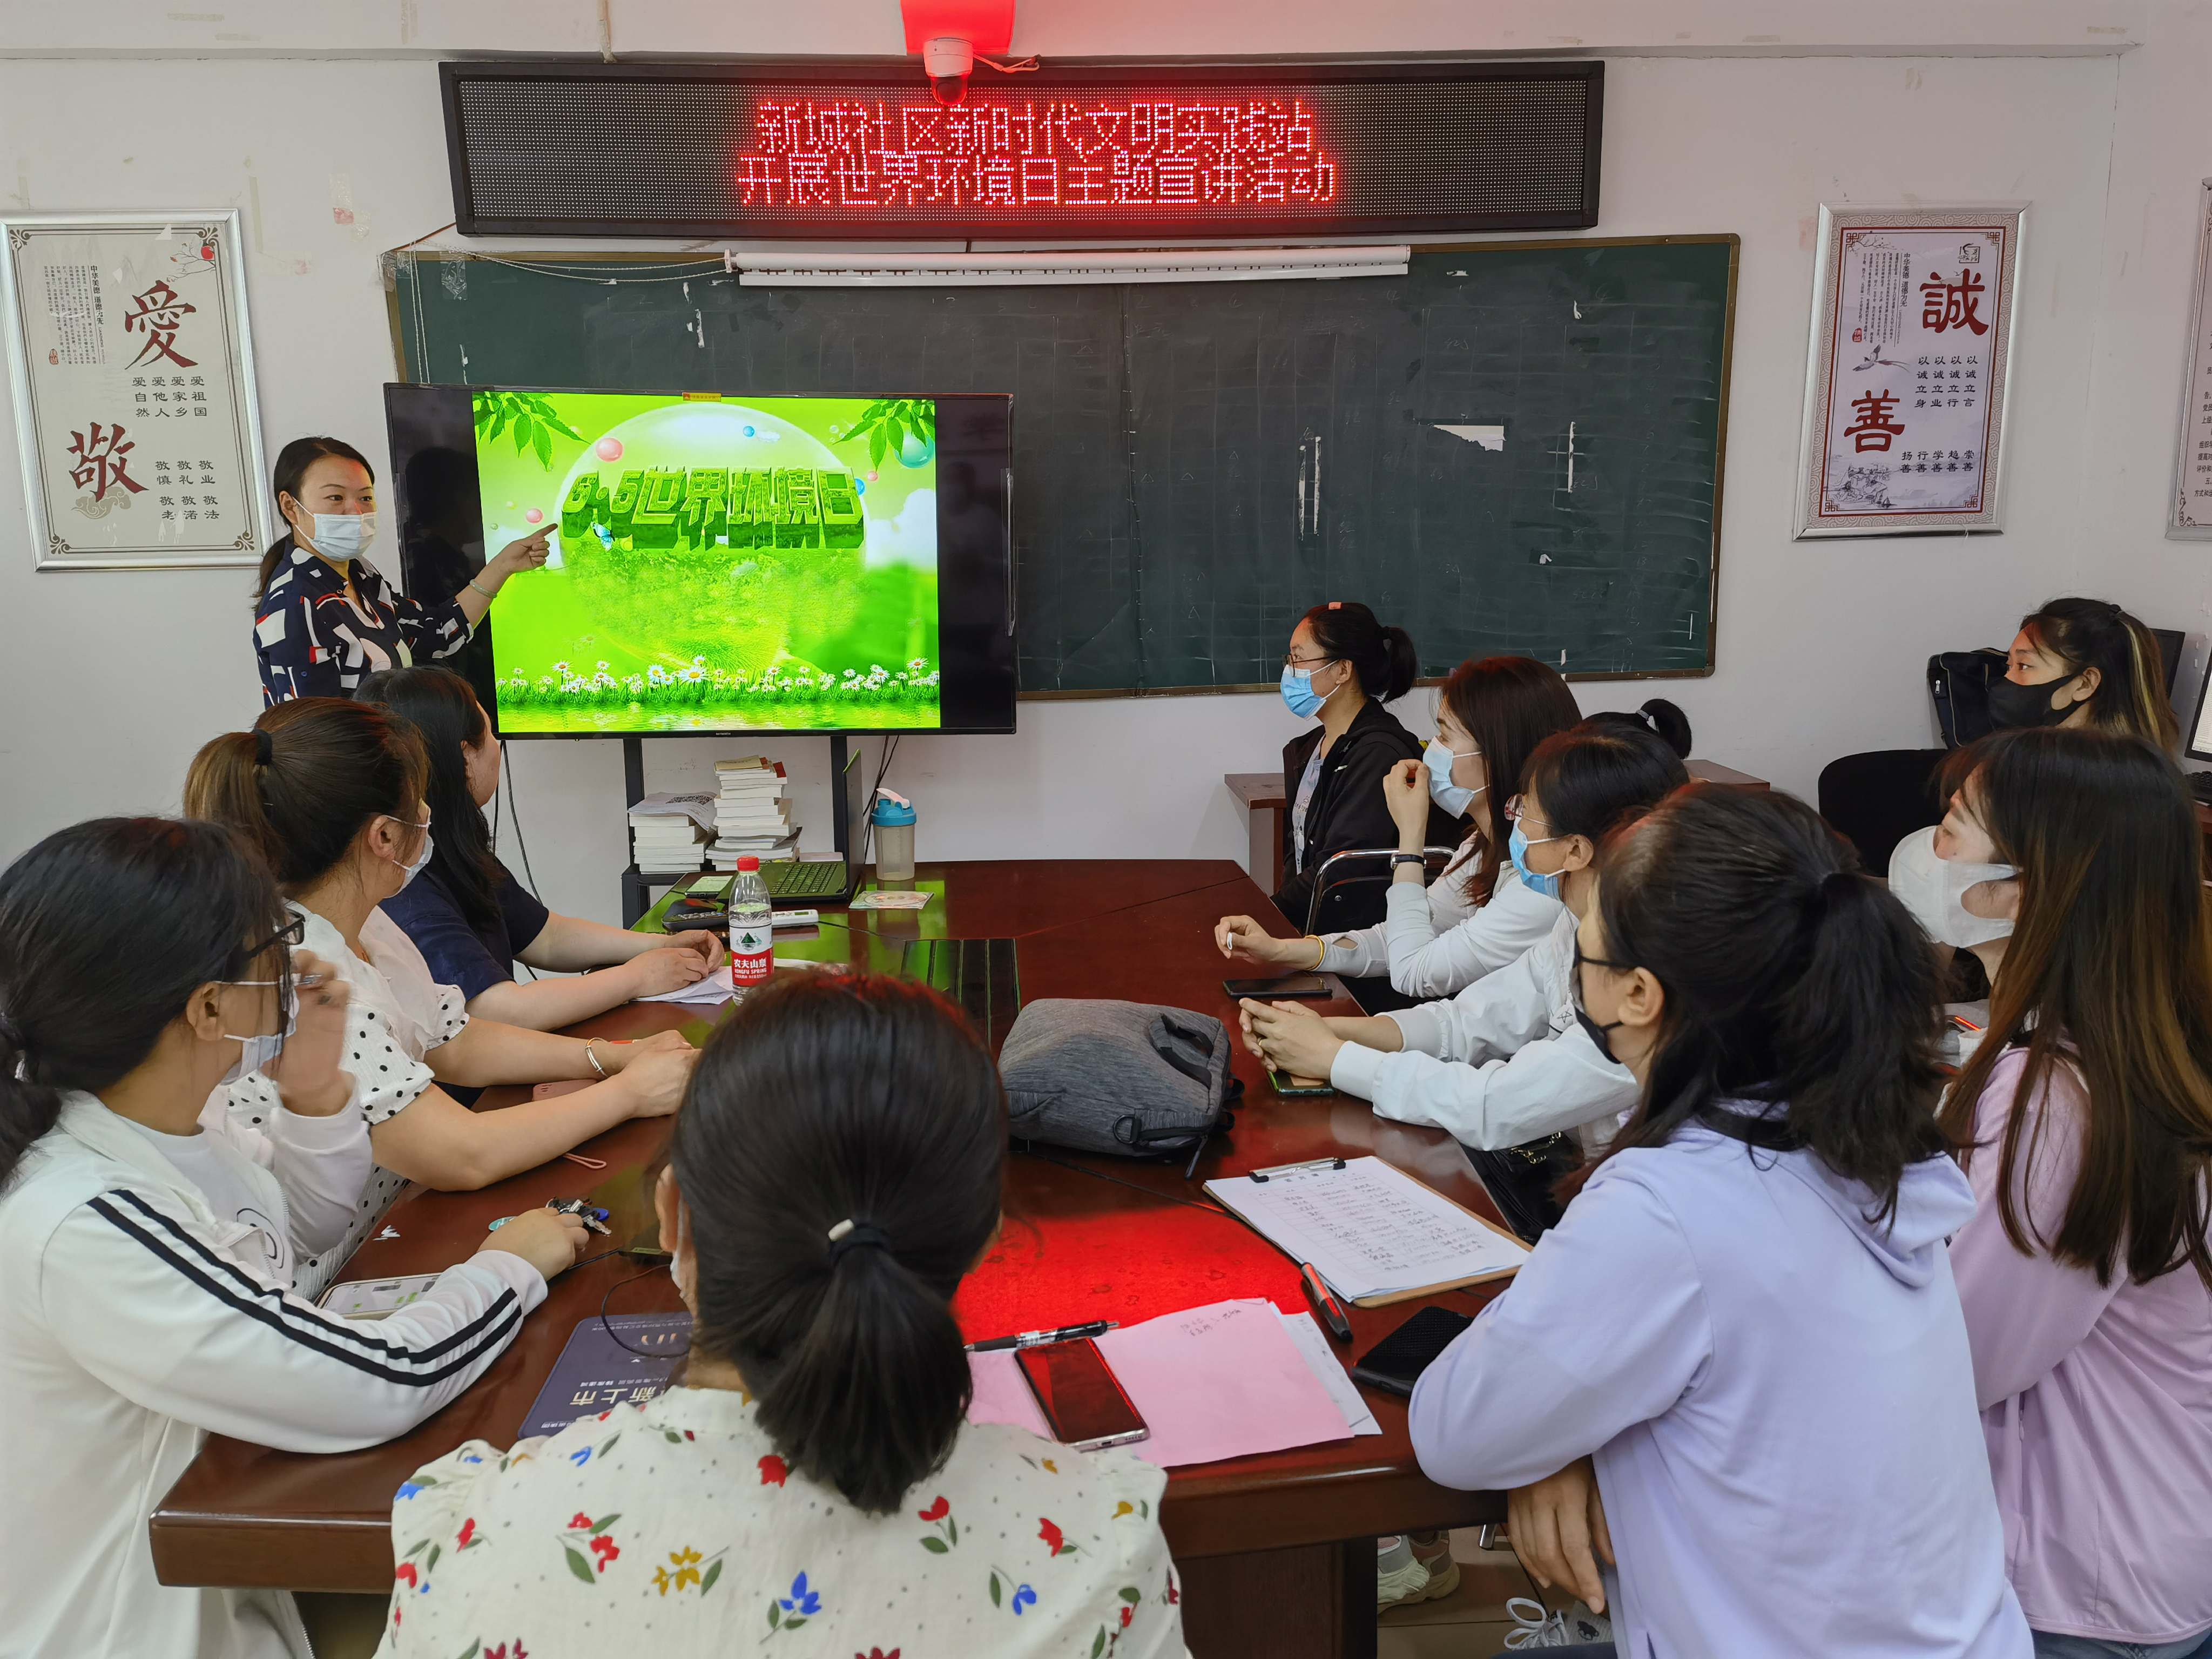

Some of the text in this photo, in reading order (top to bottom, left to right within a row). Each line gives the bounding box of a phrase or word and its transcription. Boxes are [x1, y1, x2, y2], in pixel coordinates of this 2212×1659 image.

[757, 100, 1312, 156] 新城社区新时代文明实践站
[738, 151, 1334, 204] 开展世界环境日主题宣讲活动
[1919, 268, 1989, 335] 誠
[124, 280, 199, 369] 愛
[132, 377, 150, 417] 爱自然
[151, 376, 170, 417] 爱他人
[171, 376, 187, 417] 爱家乡
[190, 376, 207, 417] 爱祖国
[1914, 356, 1930, 408] 以诚立身
[1930, 356, 1946, 407] 以诚立业
[1947, 355, 1962, 407] 以诚立行
[1963, 355, 1978, 407] 以诚立言
[1844, 389, 1905, 453] 善
[66, 422, 150, 502] 敬
[177, 461, 194, 484] 敬礼
[198, 460, 215, 484] 敬业
[1900, 451, 1912, 474] 扬善
[1916, 451, 1928, 473] 行善
[1931, 450, 1944, 473] 学善
[1962, 449, 1974, 471] 崇善
[159, 496, 176, 520] 敬老
[203, 495, 220, 519] 敬法
[734, 957, 767, 968] 农夫山泉
[570, 1386, 665, 1406] 新上市
